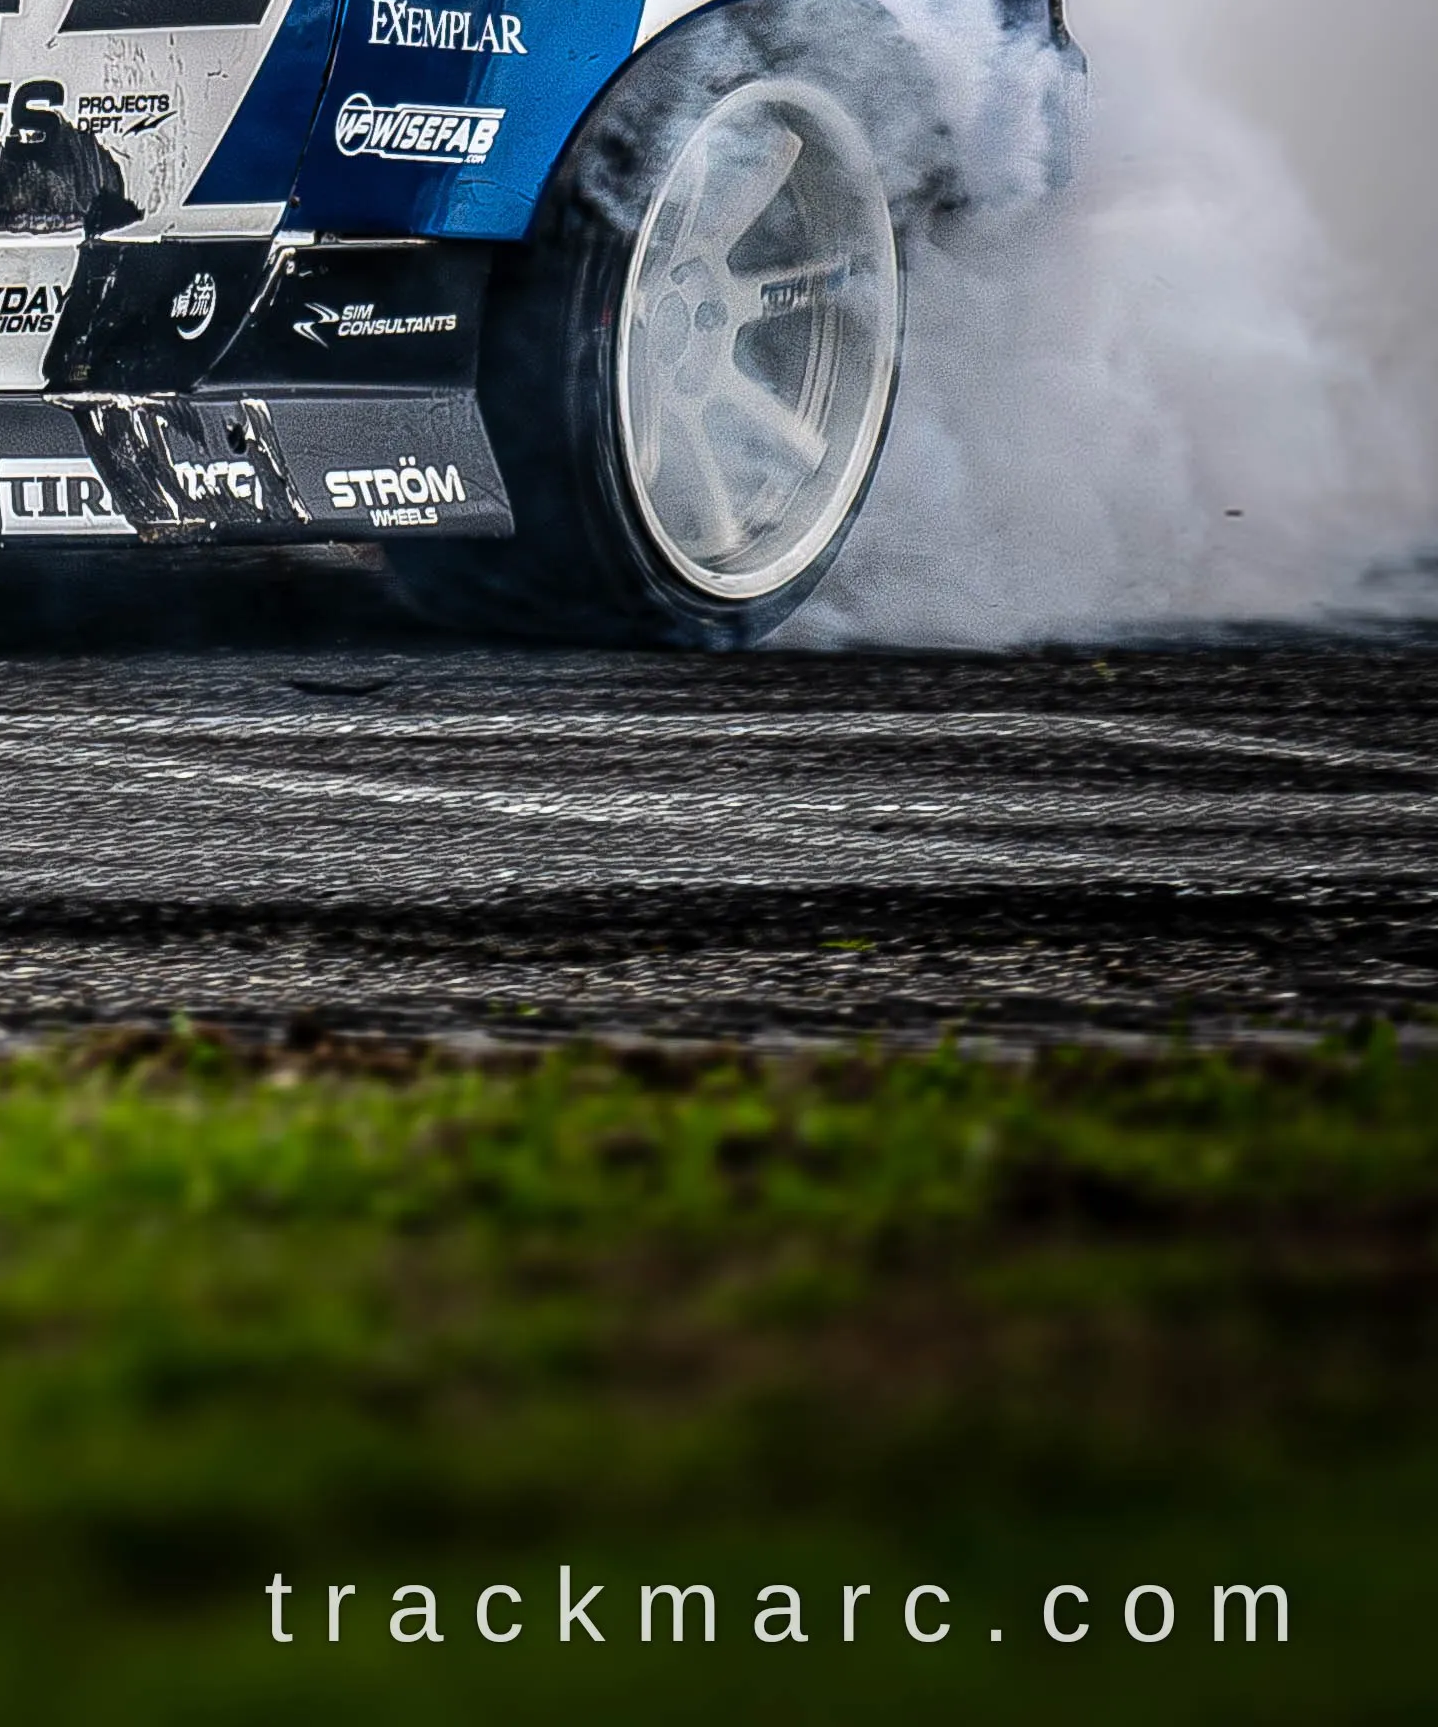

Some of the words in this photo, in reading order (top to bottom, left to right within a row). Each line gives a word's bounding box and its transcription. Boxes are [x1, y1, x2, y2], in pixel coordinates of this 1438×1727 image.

[77, 95, 171, 114] PROJECTS
[369, 110, 501, 155] WISEFAB
[341, 303, 375, 321] SIM
[337, 314, 457, 337] CONSULTANTS
[324, 455, 467, 509] STRÖM
[369, 507, 439, 527] WHEELS
